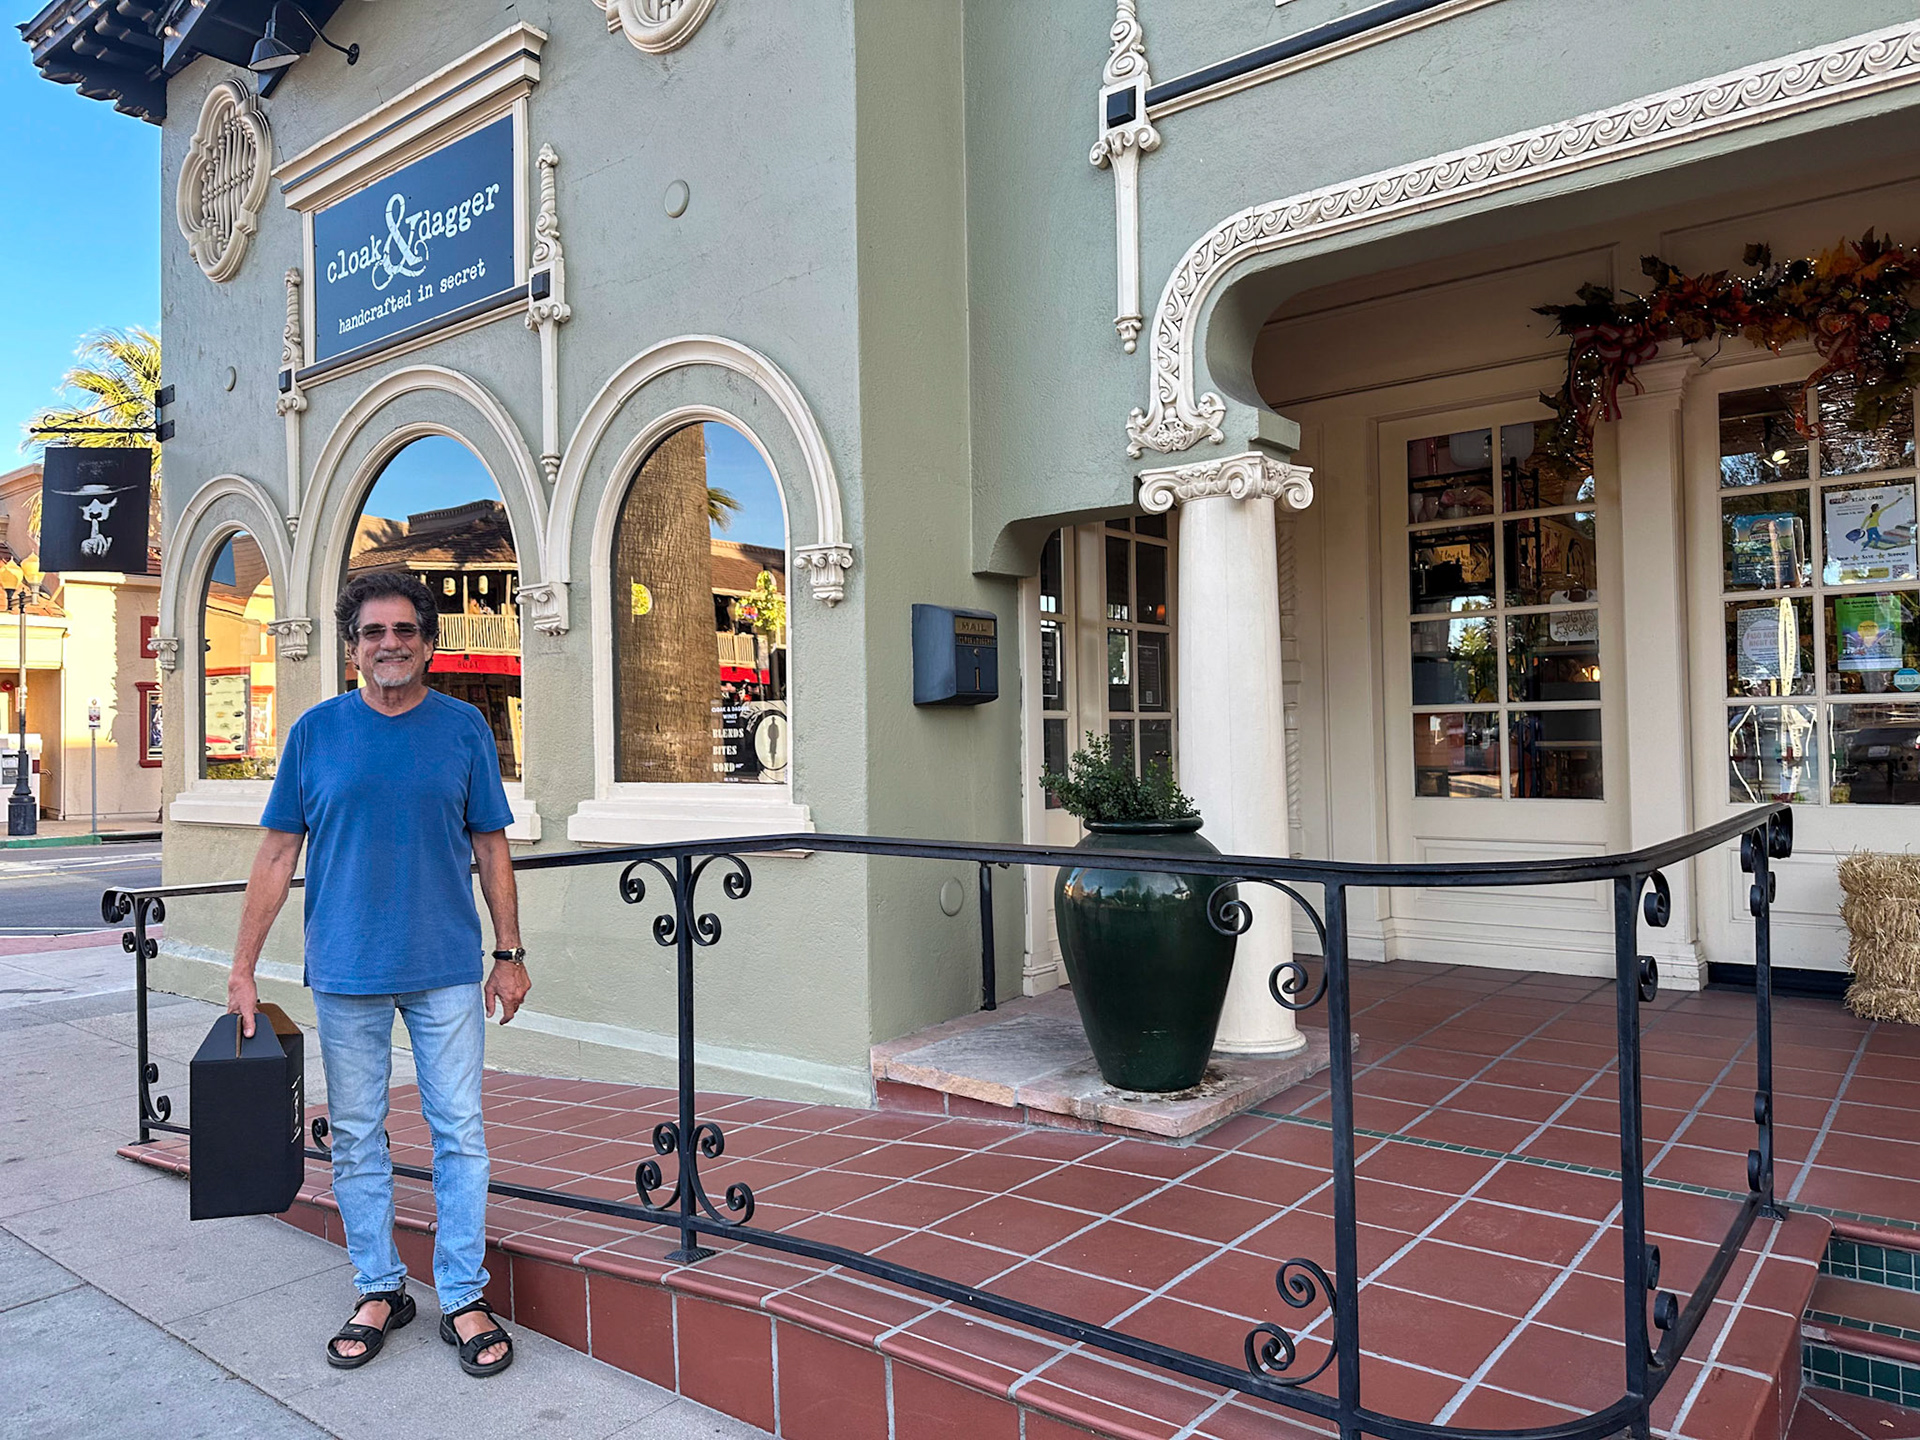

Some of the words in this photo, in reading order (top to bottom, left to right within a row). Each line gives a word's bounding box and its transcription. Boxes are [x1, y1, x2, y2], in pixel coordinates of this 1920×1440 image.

[327, 235, 385, 284] cloak
[371, 193, 429, 291] &
[418, 182, 500, 243] dagger
[338, 289, 413, 335] handcrafted
[417, 284, 434, 303] in
[439, 258, 487, 295] secret
[961, 621, 987, 632] MAIL
[1900, 675, 1916, 684] ring
[712, 728, 745, 738] BLENDS
[712, 745, 738, 755] BITES
[713, 762, 735, 772] BOND
